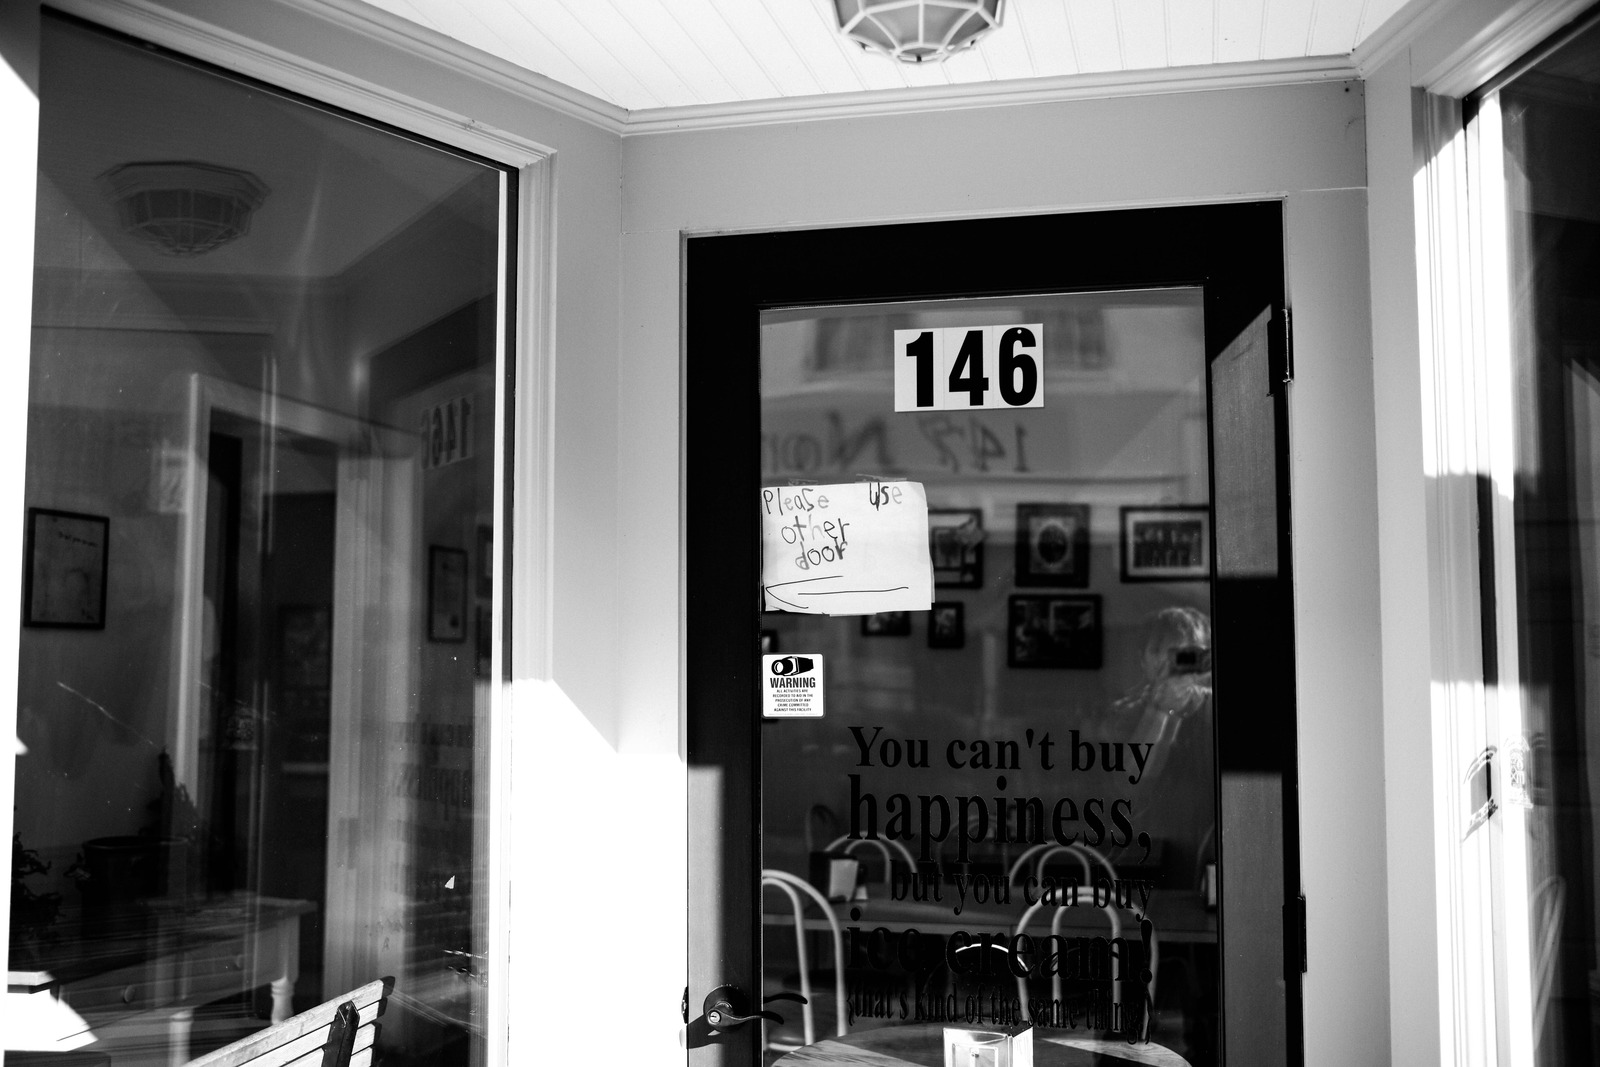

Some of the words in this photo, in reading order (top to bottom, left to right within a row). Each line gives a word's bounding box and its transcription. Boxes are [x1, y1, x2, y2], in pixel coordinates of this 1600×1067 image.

[905, 326, 1038, 409] 146
[781, 514, 850, 544] other
[795, 538, 848, 570] door
[769, 677, 816, 689] WARNING
[847, 726, 931, 769] You
[946, 728, 1055, 770] can't
[1068, 729, 1154, 785] buy
[847, 774, 1152, 865] happiness,
[890, 859, 944, 902] but
[951, 872, 1012, 915] you
[1023, 875, 1080, 907] can
[1092, 866, 1155, 922] buy
[847, 908, 922, 972] ice
[945, 919, 1153, 984] cream!
[915, 980, 958, 1022] kind
[965, 983, 986, 1024] of
[991, 985, 1021, 1026] the
[1028, 998, 1079, 1030] same
